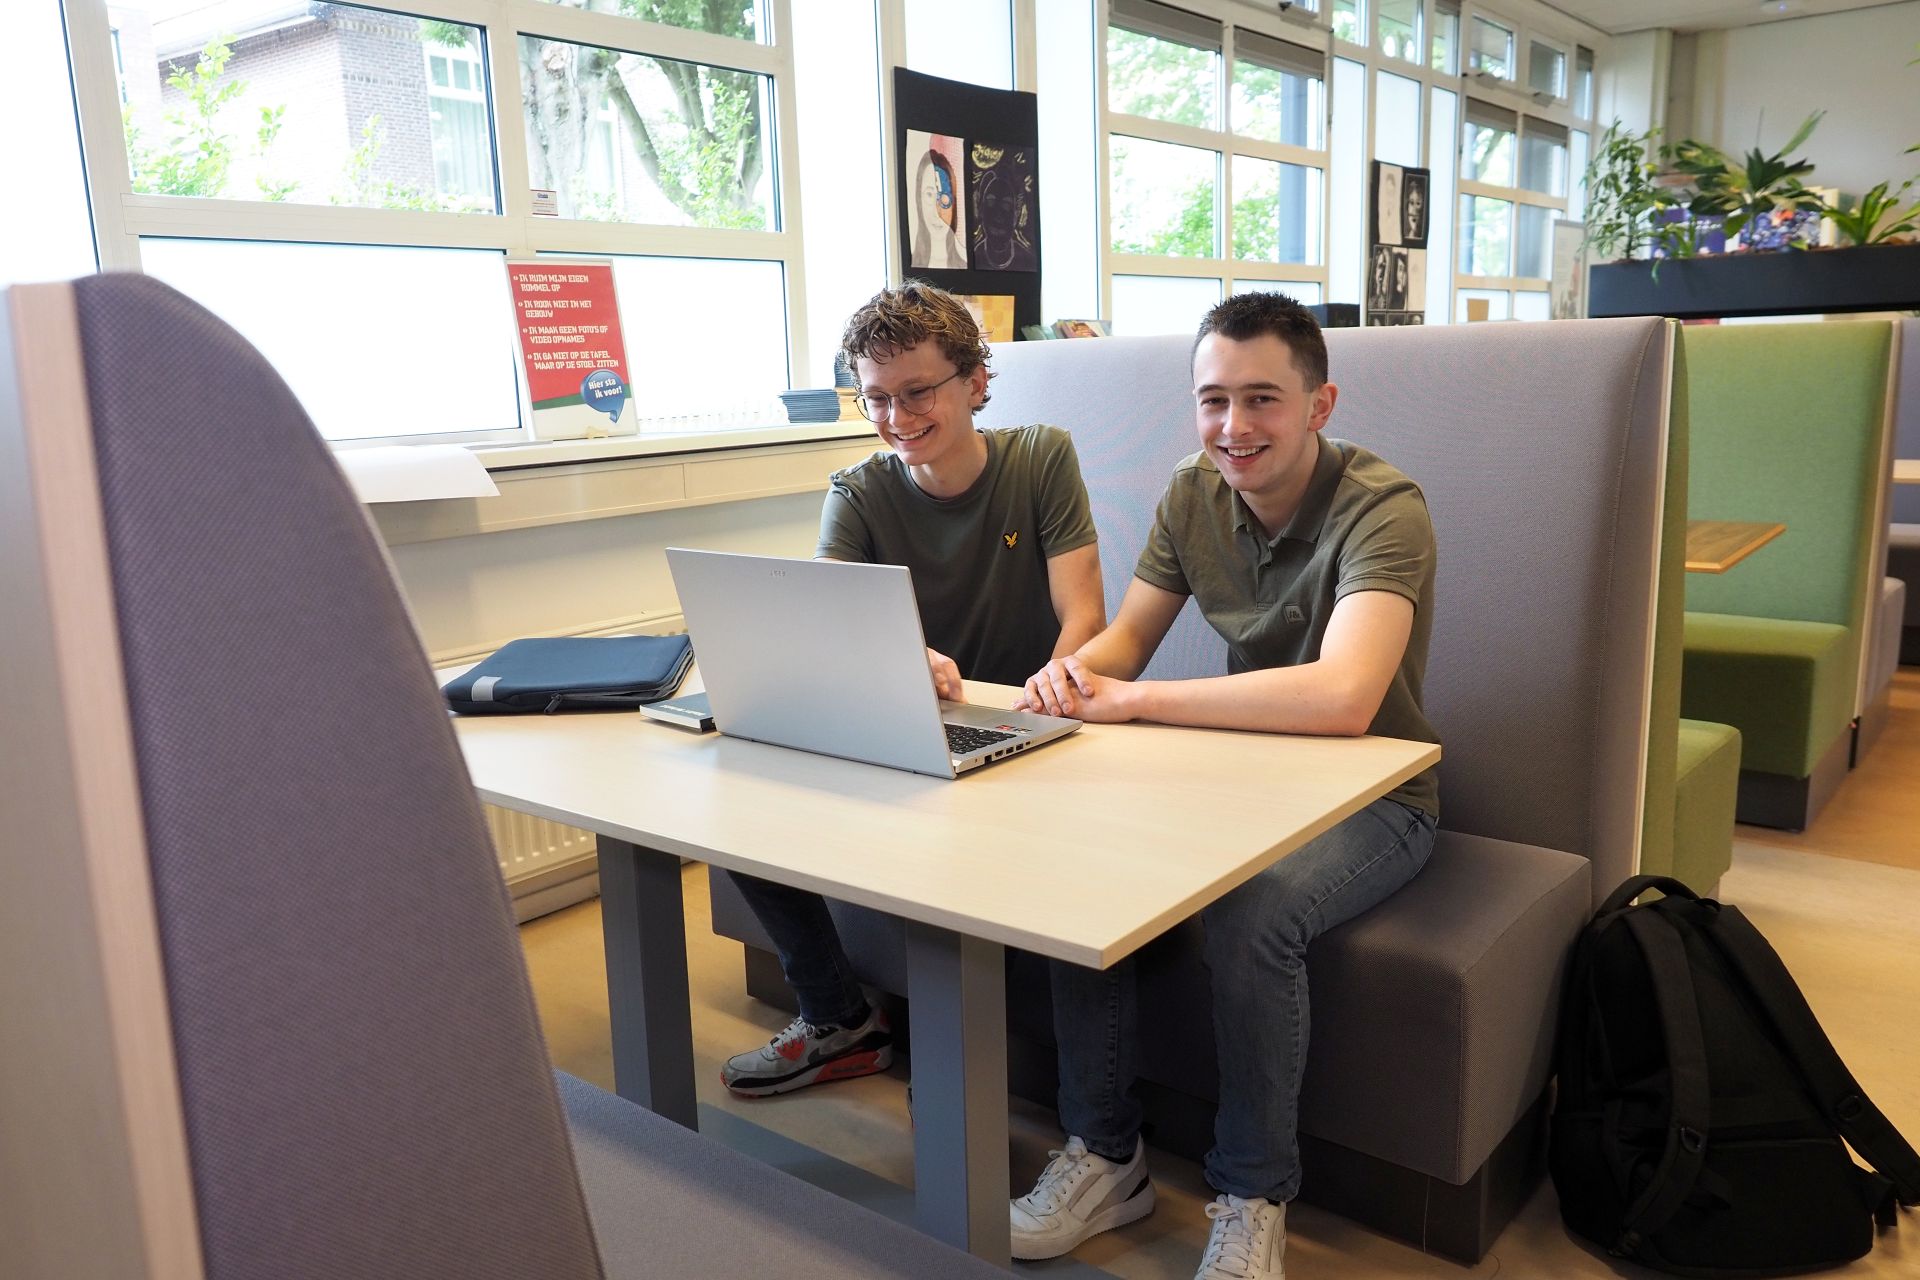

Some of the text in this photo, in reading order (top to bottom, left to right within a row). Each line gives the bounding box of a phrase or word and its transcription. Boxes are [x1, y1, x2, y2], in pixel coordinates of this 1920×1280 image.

[519, 274, 528, 282] IK
[529, 274, 547, 282] RUIM
[533, 352, 542, 360] IK
[588, 378, 616, 390] Hier sta
[595, 386, 622, 399] ik voor!
